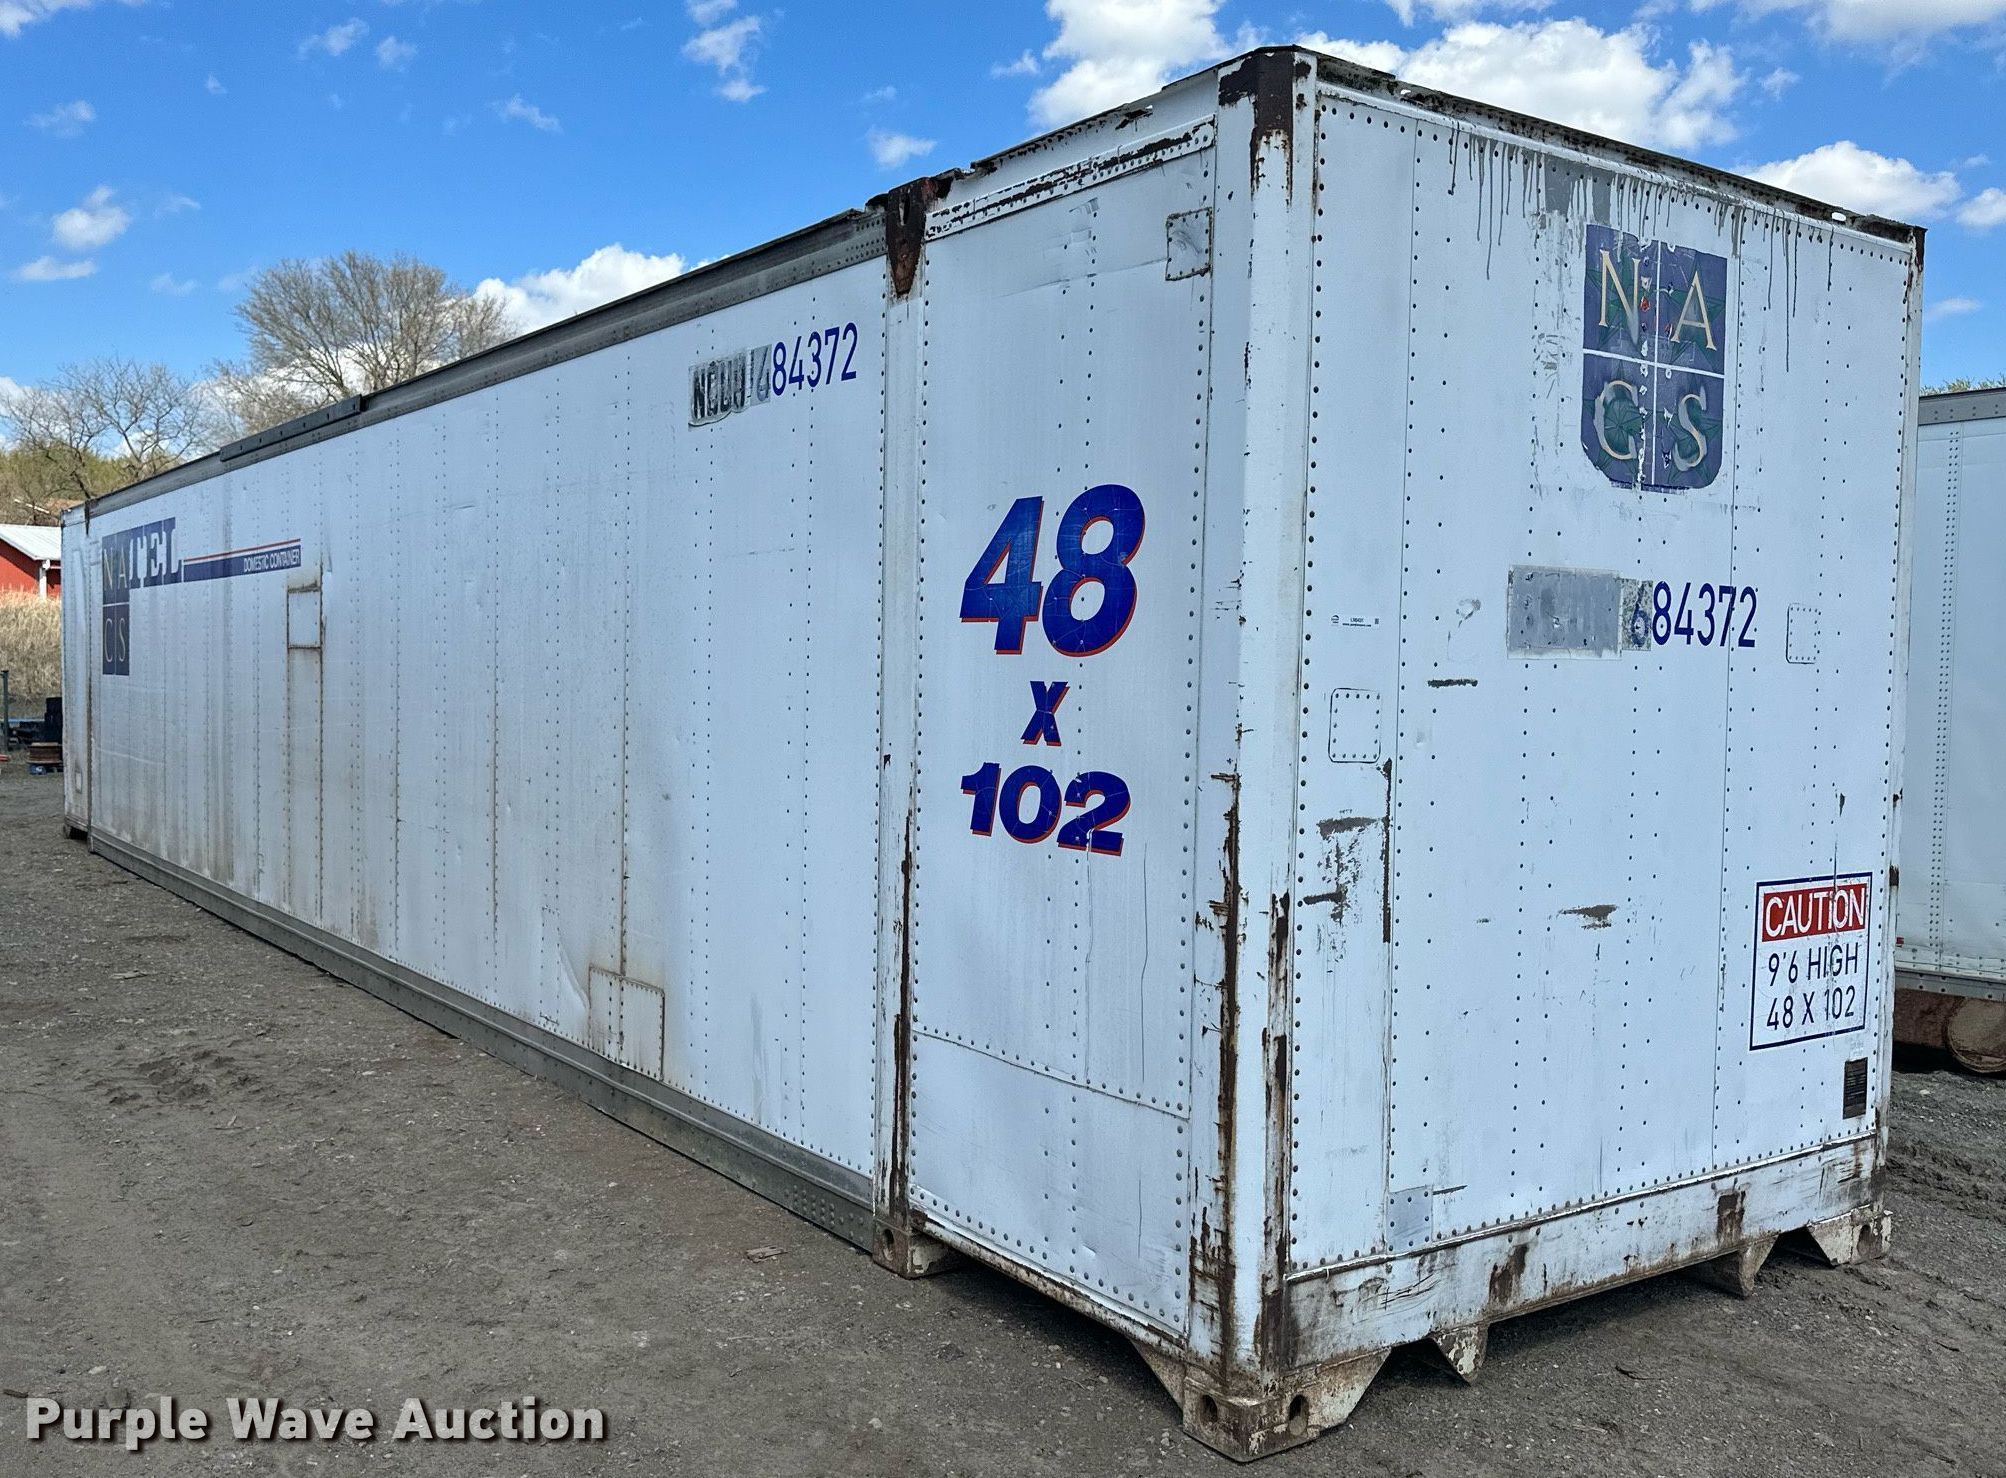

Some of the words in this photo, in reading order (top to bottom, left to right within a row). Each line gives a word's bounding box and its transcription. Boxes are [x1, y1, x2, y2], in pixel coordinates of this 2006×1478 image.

[959, 484, 1145, 658] 48
[960, 762, 1131, 857] 102
[1765, 888, 1866, 938] CAUTION
[1768, 950, 1799, 987] 9'6
[1807, 942, 1859, 981] HIGH
[1766, 995, 1794, 1031] 48
[1801, 991, 1816, 1026] X
[1824, 985, 1856, 1022] 102
